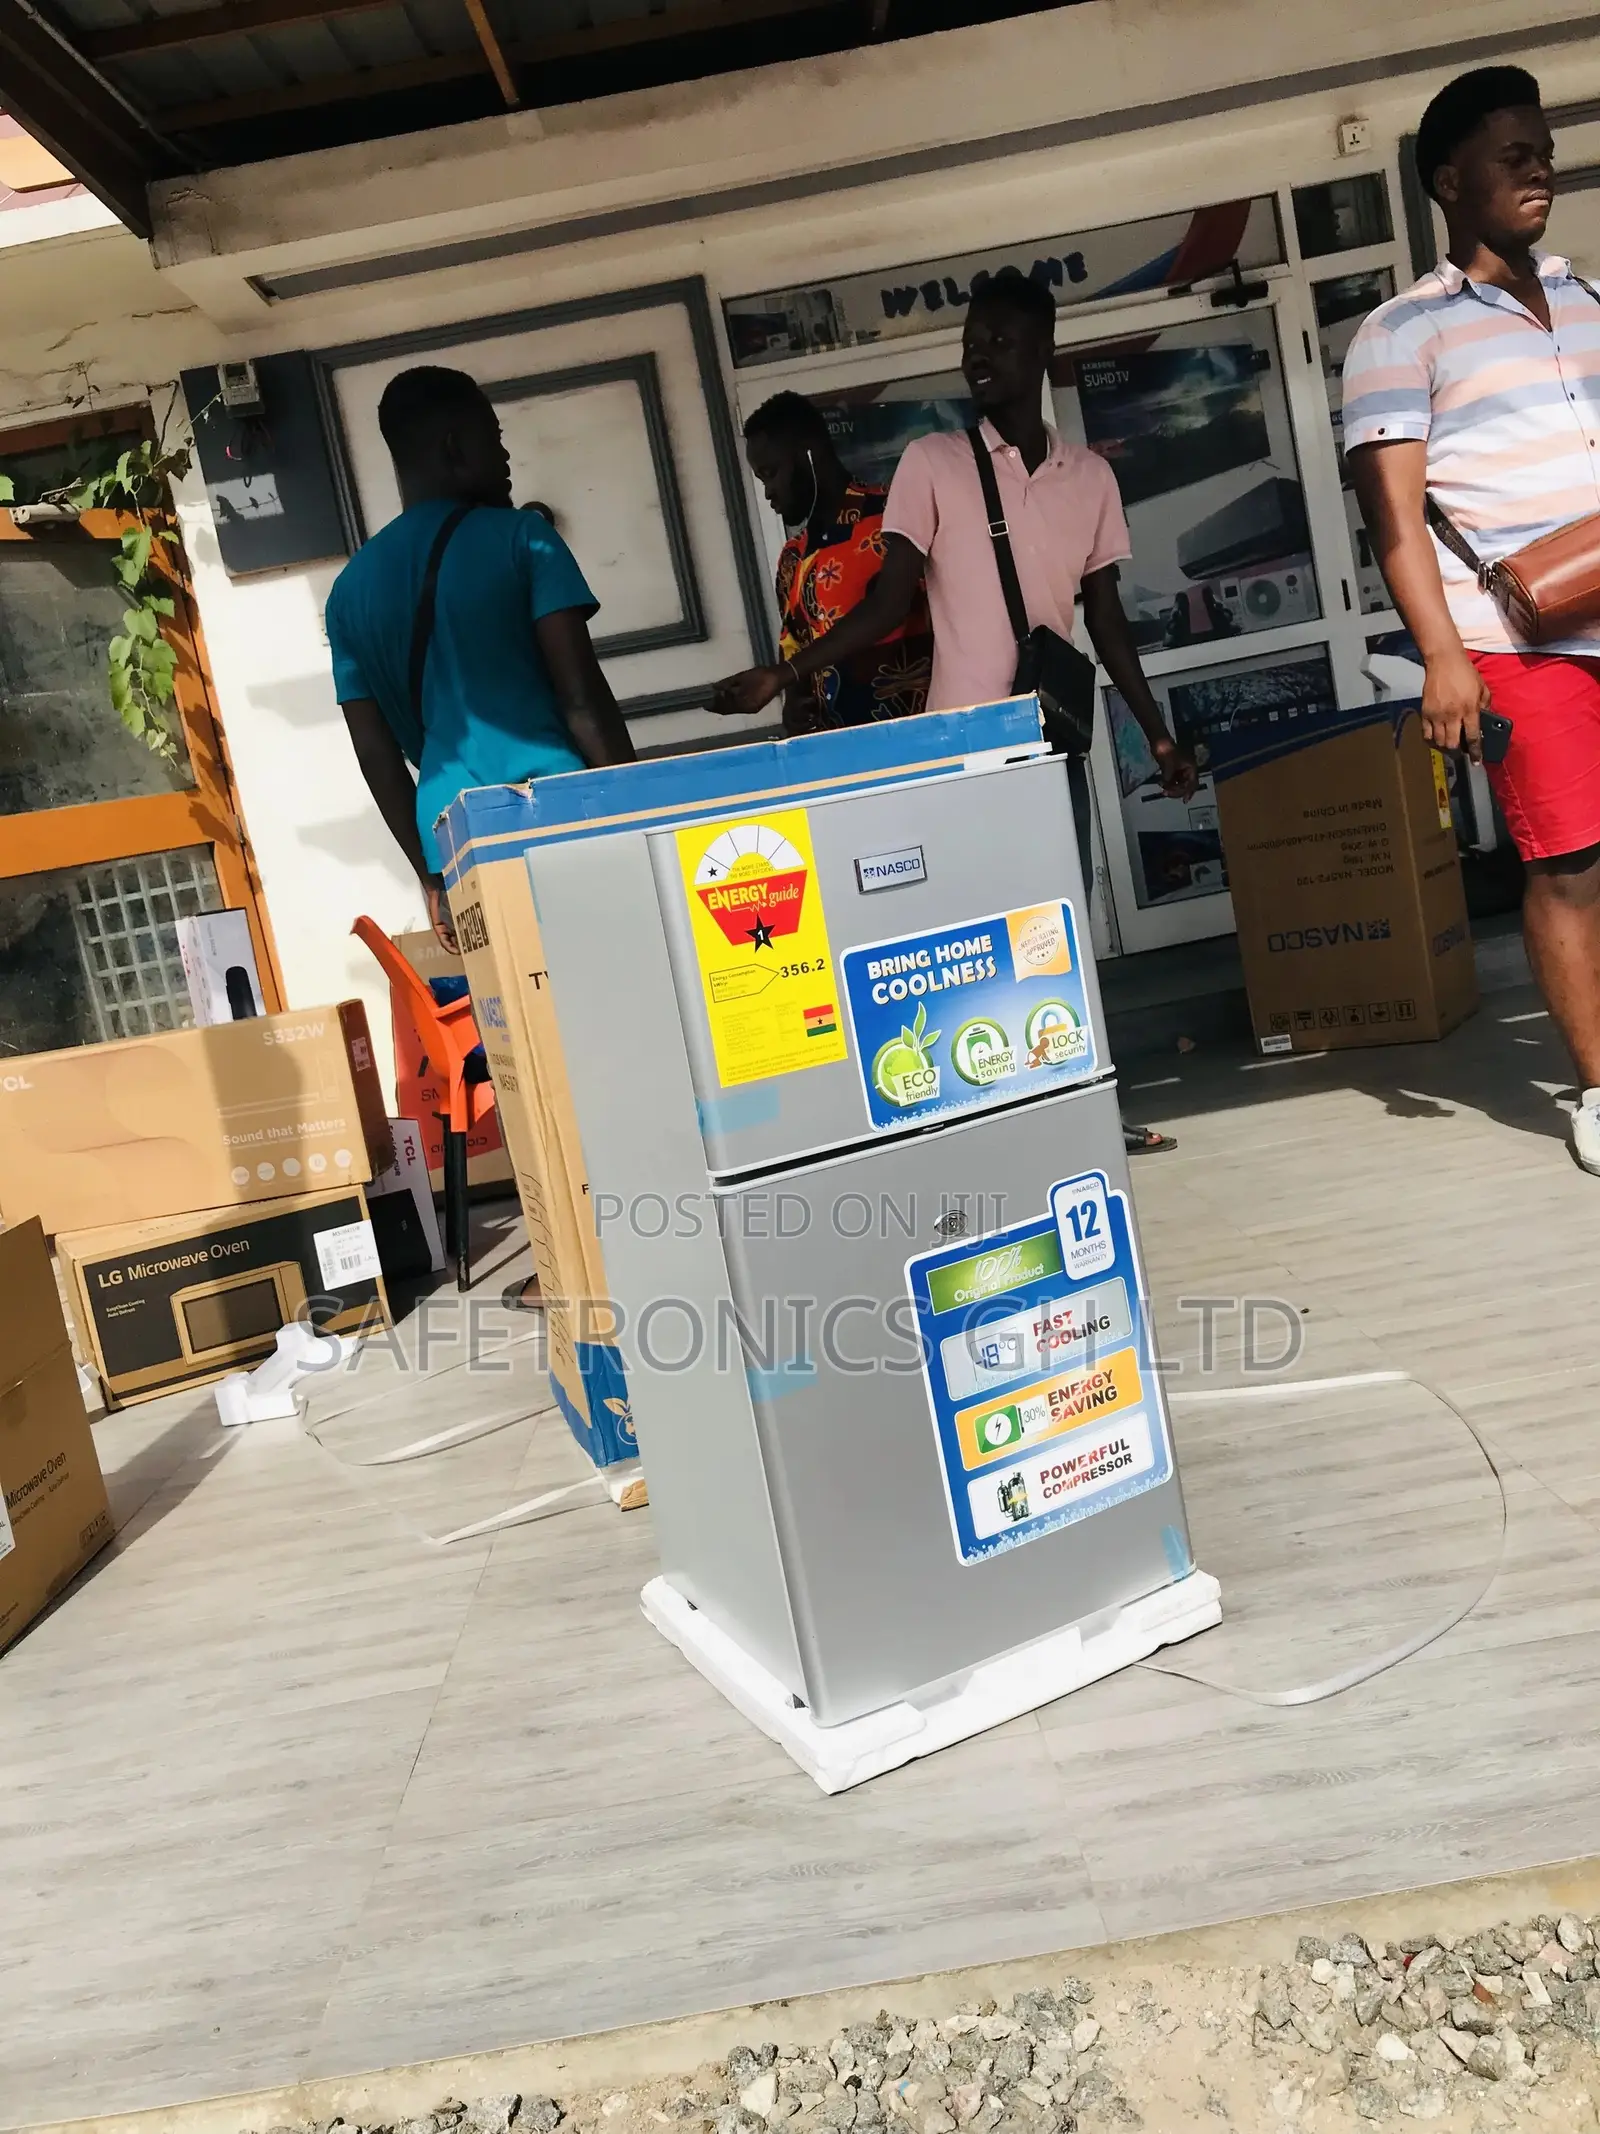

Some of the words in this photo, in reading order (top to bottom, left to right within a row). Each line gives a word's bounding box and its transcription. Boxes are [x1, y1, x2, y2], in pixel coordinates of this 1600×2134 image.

[875, 858, 920, 878] NASCO
[707, 883, 768, 913] ENERGY
[768, 884, 800, 907] guide
[757, 929, 765, 941] 1
[1267, 919, 1364, 953] NASCO
[780, 958, 826, 979] 356.2
[866, 949, 932, 981] BRING
[935, 934, 993, 964] HOME
[871, 955, 998, 1006] COOLNESS
[262, 1022, 325, 1046] S332W
[1052, 1028, 1085, 1050] LOCK
[978, 1049, 1014, 1069] ENERGY
[1054, 1044, 1086, 1060] security
[902, 1069, 937, 1091] ECO
[980, 1061, 1016, 1079] saving
[0, 1075, 34, 1092] CL
[905, 1085, 939, 1102] friendly
[222, 1129, 264, 1146] Sound
[267, 1125, 294, 1140] that
[297, 1117, 347, 1134] Matters
[403, 1135, 417, 1167] TCL
[1076, 1181, 1100, 1193] NASCO
[1065, 1199, 1101, 1243] 12
[1070, 1240, 1107, 1260] MONTHS
[1074, 1253, 1108, 1270] WARRANTY
[98, 1269, 124, 1289] LG
[127, 1249, 209, 1281] Microwave
[210, 1239, 250, 1259] Oven
[1032, 1309, 1074, 1337] FAST
[1036, 1315, 1111, 1354] COOLING
[1047, 1368, 1113, 1407] ENERGY
[1023, 1405, 1046, 1424] 30%
[1050, 1386, 1118, 1423] SAVING
[1039, 1438, 1130, 1485] POWERFUL
[6, 1469, 48, 1509] Microwave
[46, 1451, 67, 1476] Oven
[1043, 1453, 1133, 1500] COMPRESSOR
